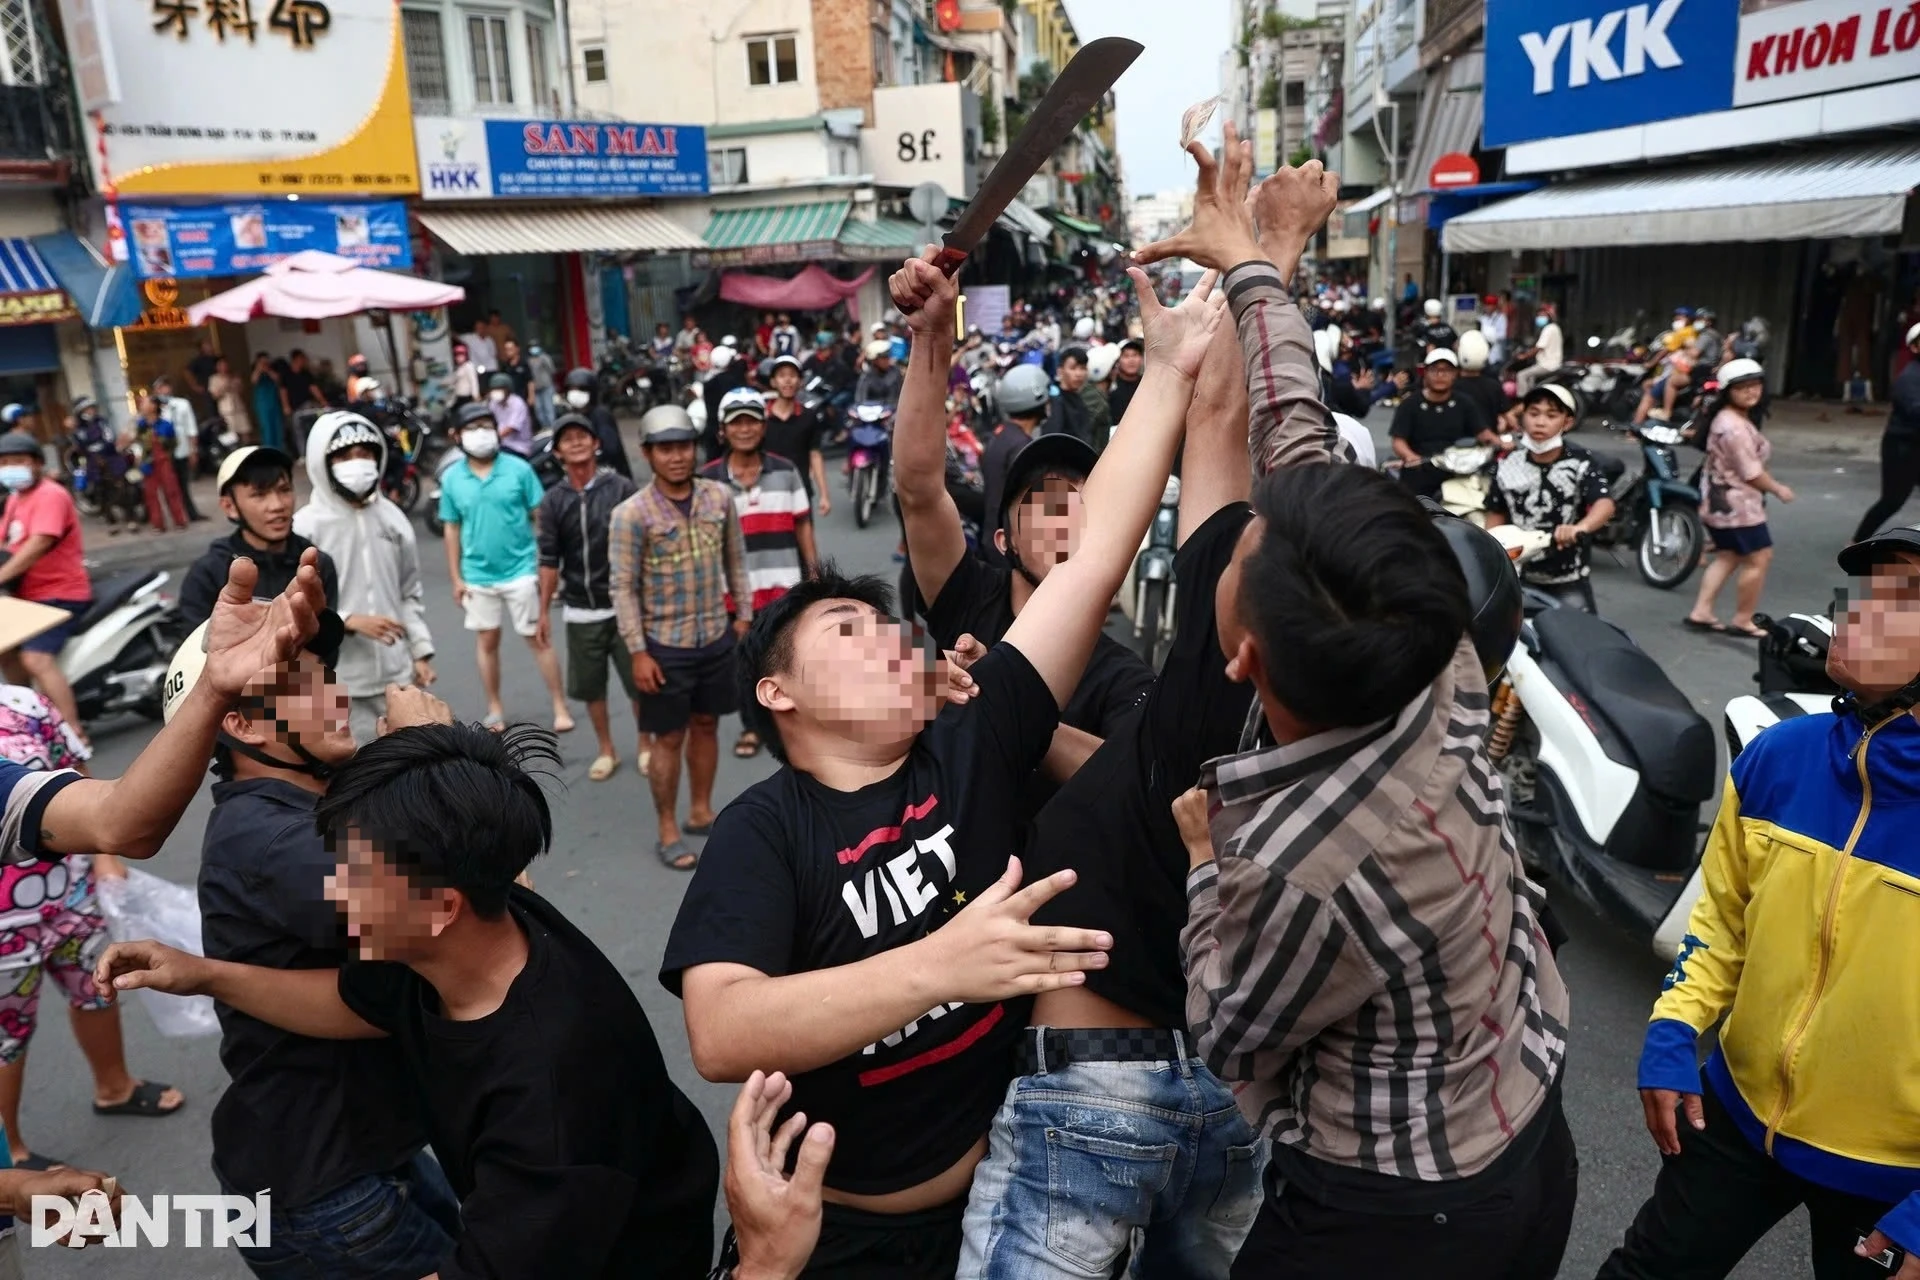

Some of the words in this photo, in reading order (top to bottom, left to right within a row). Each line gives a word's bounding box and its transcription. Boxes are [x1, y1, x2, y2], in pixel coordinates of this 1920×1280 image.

[1518, 0, 1683, 95] YKK
[523, 122, 599, 156] SAN
[605, 126, 678, 157] MAI
[898, 128, 941, 162] 8f.
[430, 169, 480, 189] HKK
[842, 823, 956, 939] VIET
